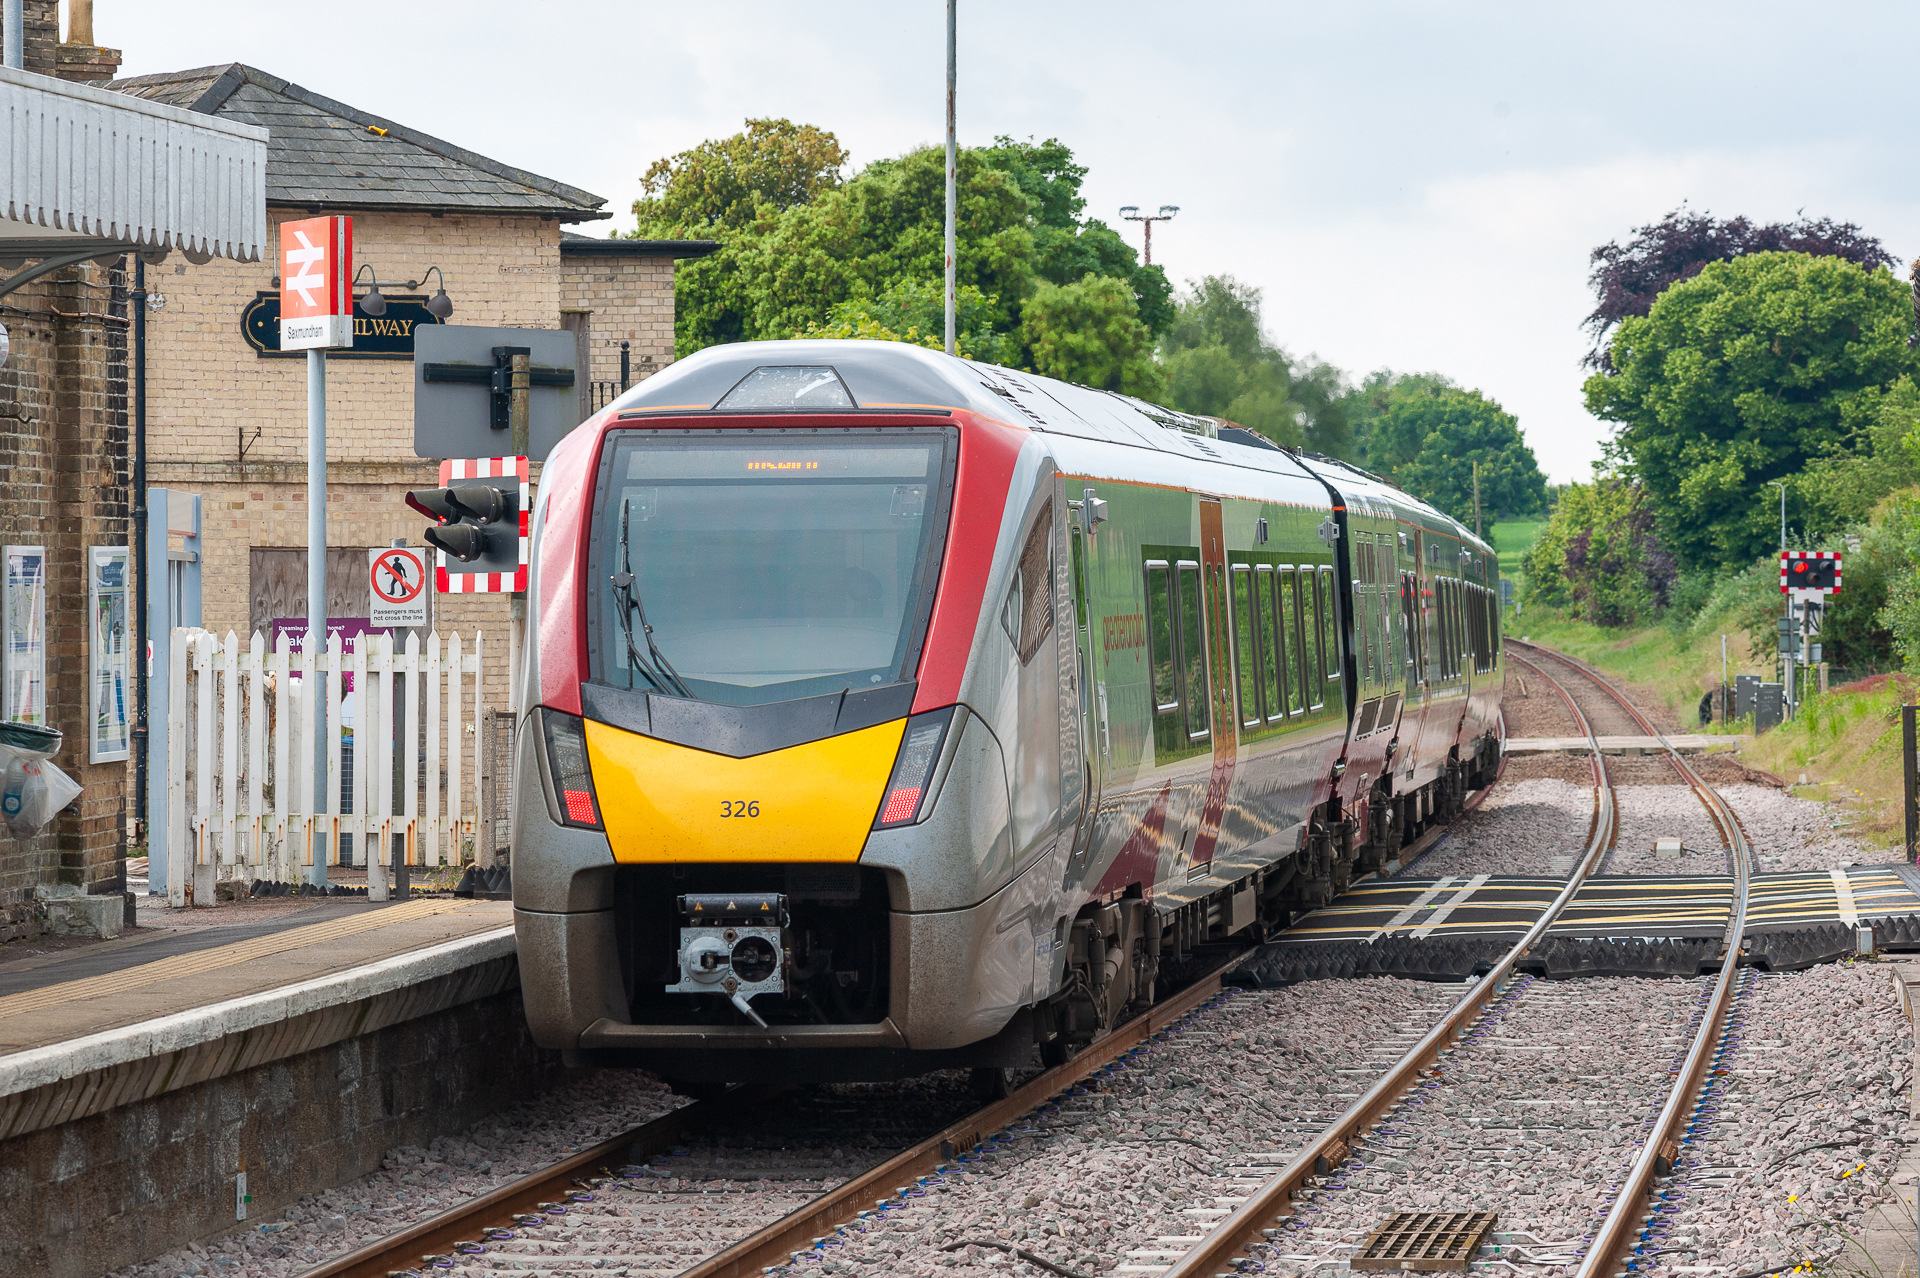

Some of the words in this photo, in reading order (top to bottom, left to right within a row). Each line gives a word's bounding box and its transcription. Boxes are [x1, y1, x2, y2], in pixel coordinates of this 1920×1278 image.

[287, 324, 324, 340] Saxmundham
[353, 318, 414, 337] ILWAY
[720, 800, 760, 818] 326
